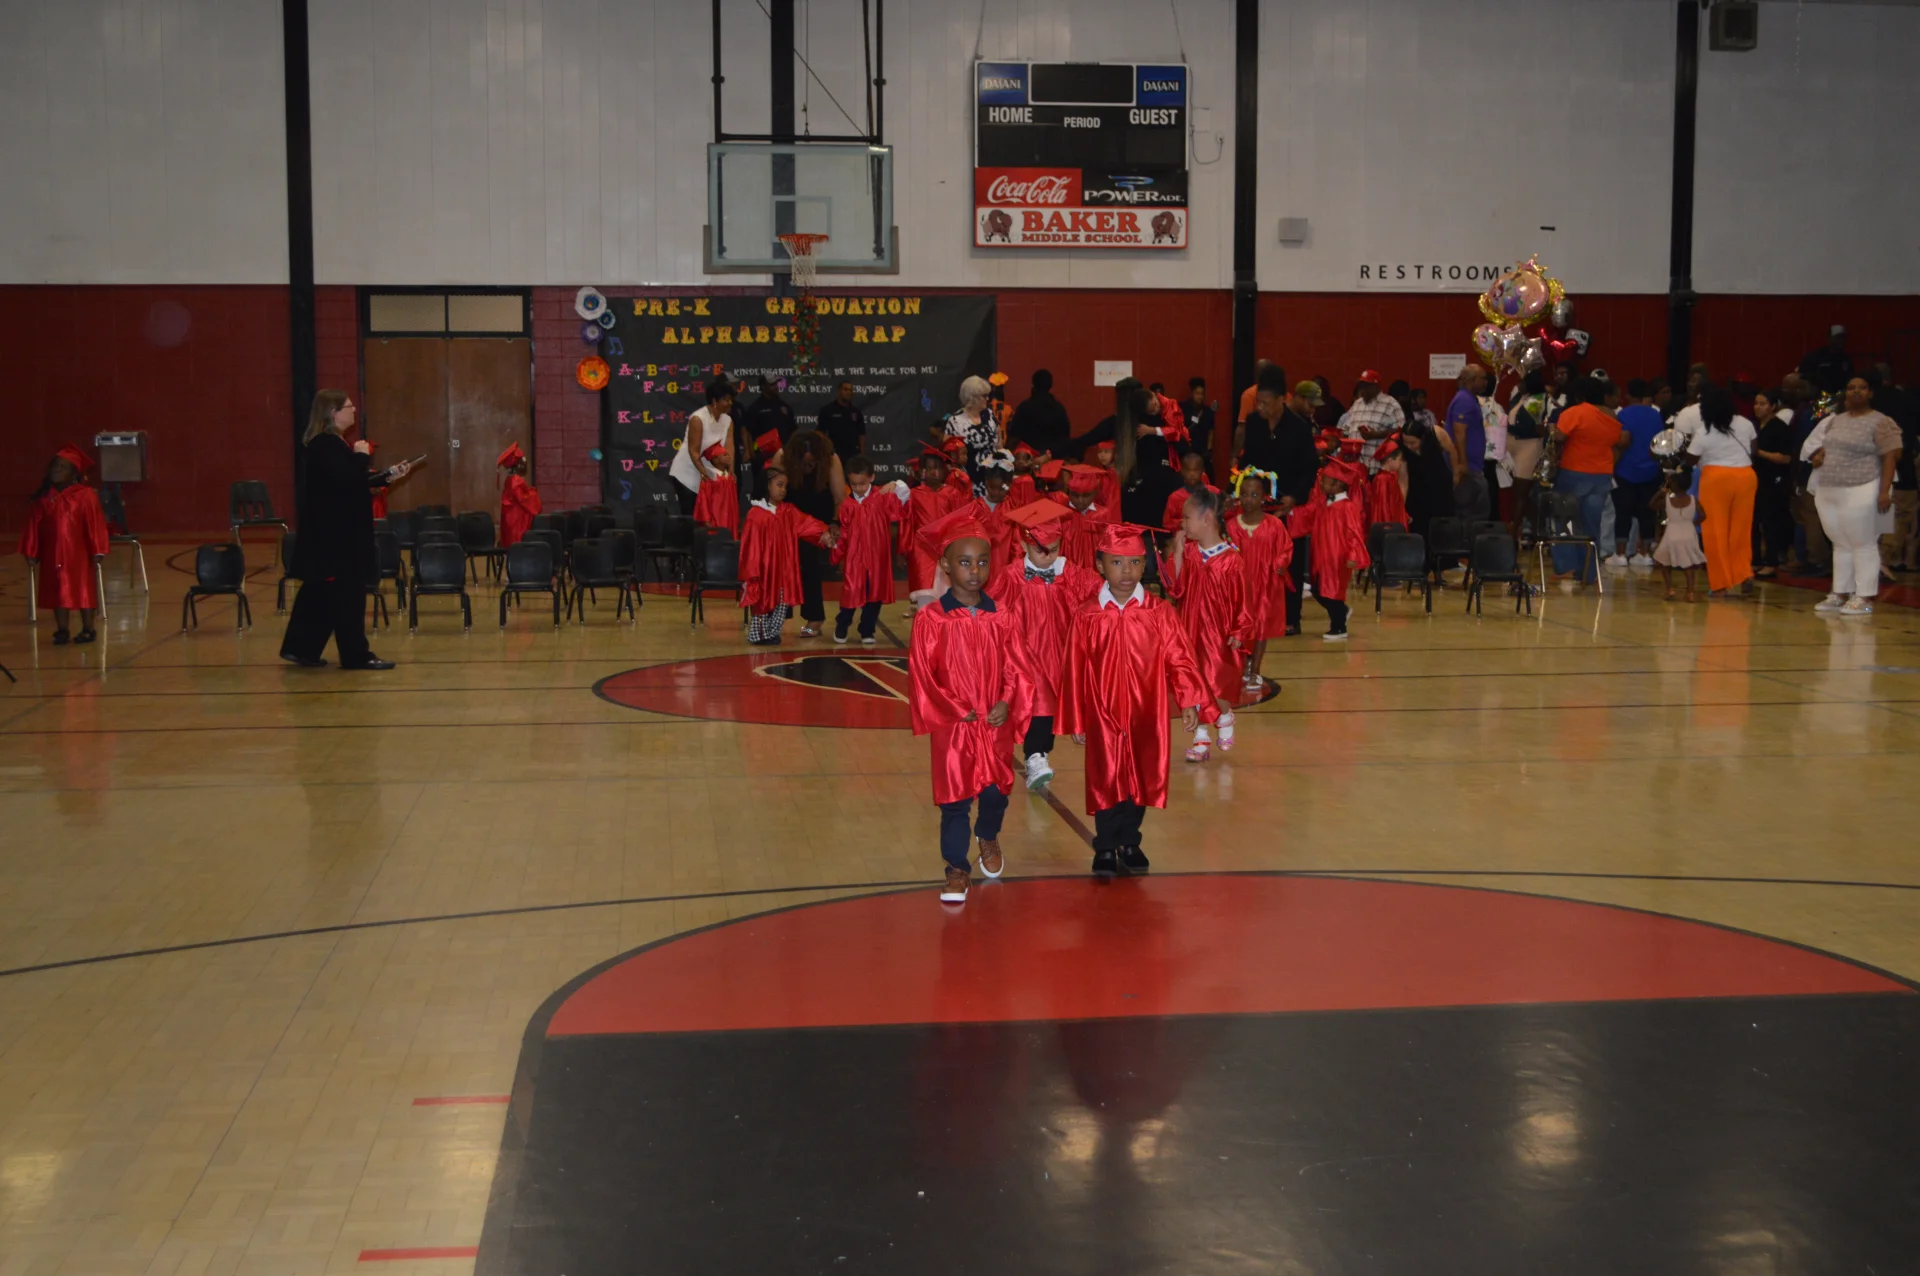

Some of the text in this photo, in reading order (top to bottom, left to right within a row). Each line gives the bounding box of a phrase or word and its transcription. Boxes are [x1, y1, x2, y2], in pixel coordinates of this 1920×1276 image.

[984, 78, 1021, 90] DASANI
[1143, 80, 1179, 92] DASANI
[989, 107, 1033, 123] HOME
[1064, 116, 1101, 128] PERIOD
[1129, 108, 1178, 125] GUEST
[987, 175, 1072, 205] Coca-Cola
[1021, 210, 1141, 233] BAKER
[1021, 233, 1142, 244] MIDDLE SCHOOL
[633, 297, 921, 316] PRE-K GRDUATION
[853, 325, 906, 343] RAP
[834, 367, 845, 376] BE
[849, 366, 865, 375] THE
[870, 366, 896, 375] PLACE
[900, 366, 917, 375] FOR
[921, 365, 938, 374] ME!
[810, 385, 833, 394] BEST
